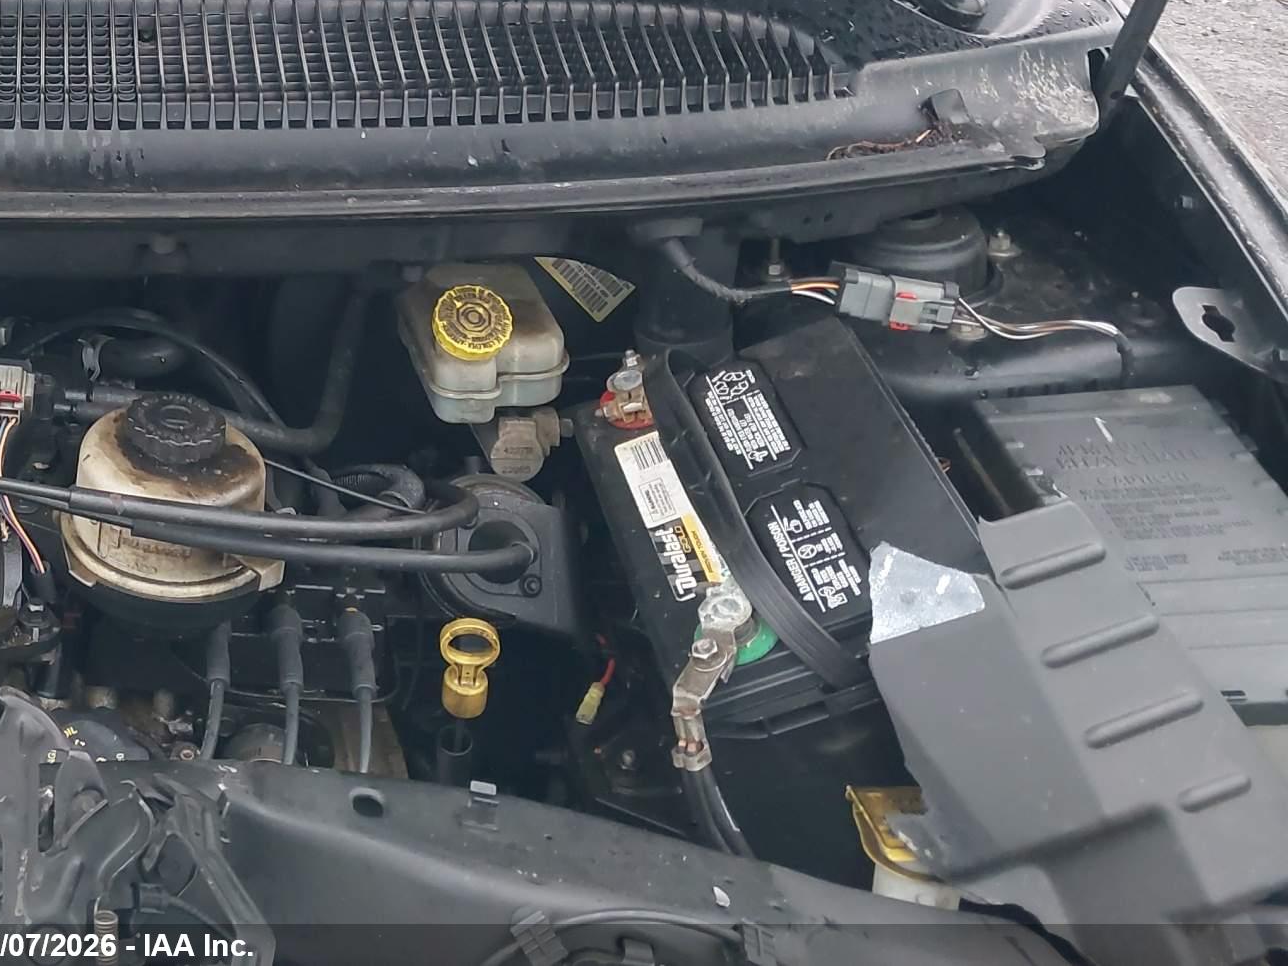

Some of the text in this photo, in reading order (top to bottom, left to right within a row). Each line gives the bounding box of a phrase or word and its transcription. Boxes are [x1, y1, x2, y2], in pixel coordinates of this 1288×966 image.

[674, 525, 692, 553] GOLD
[767, 521, 790, 553] POISON
[655, 527, 697, 595] Duralast
[785, 557, 811, 594] DANGER
